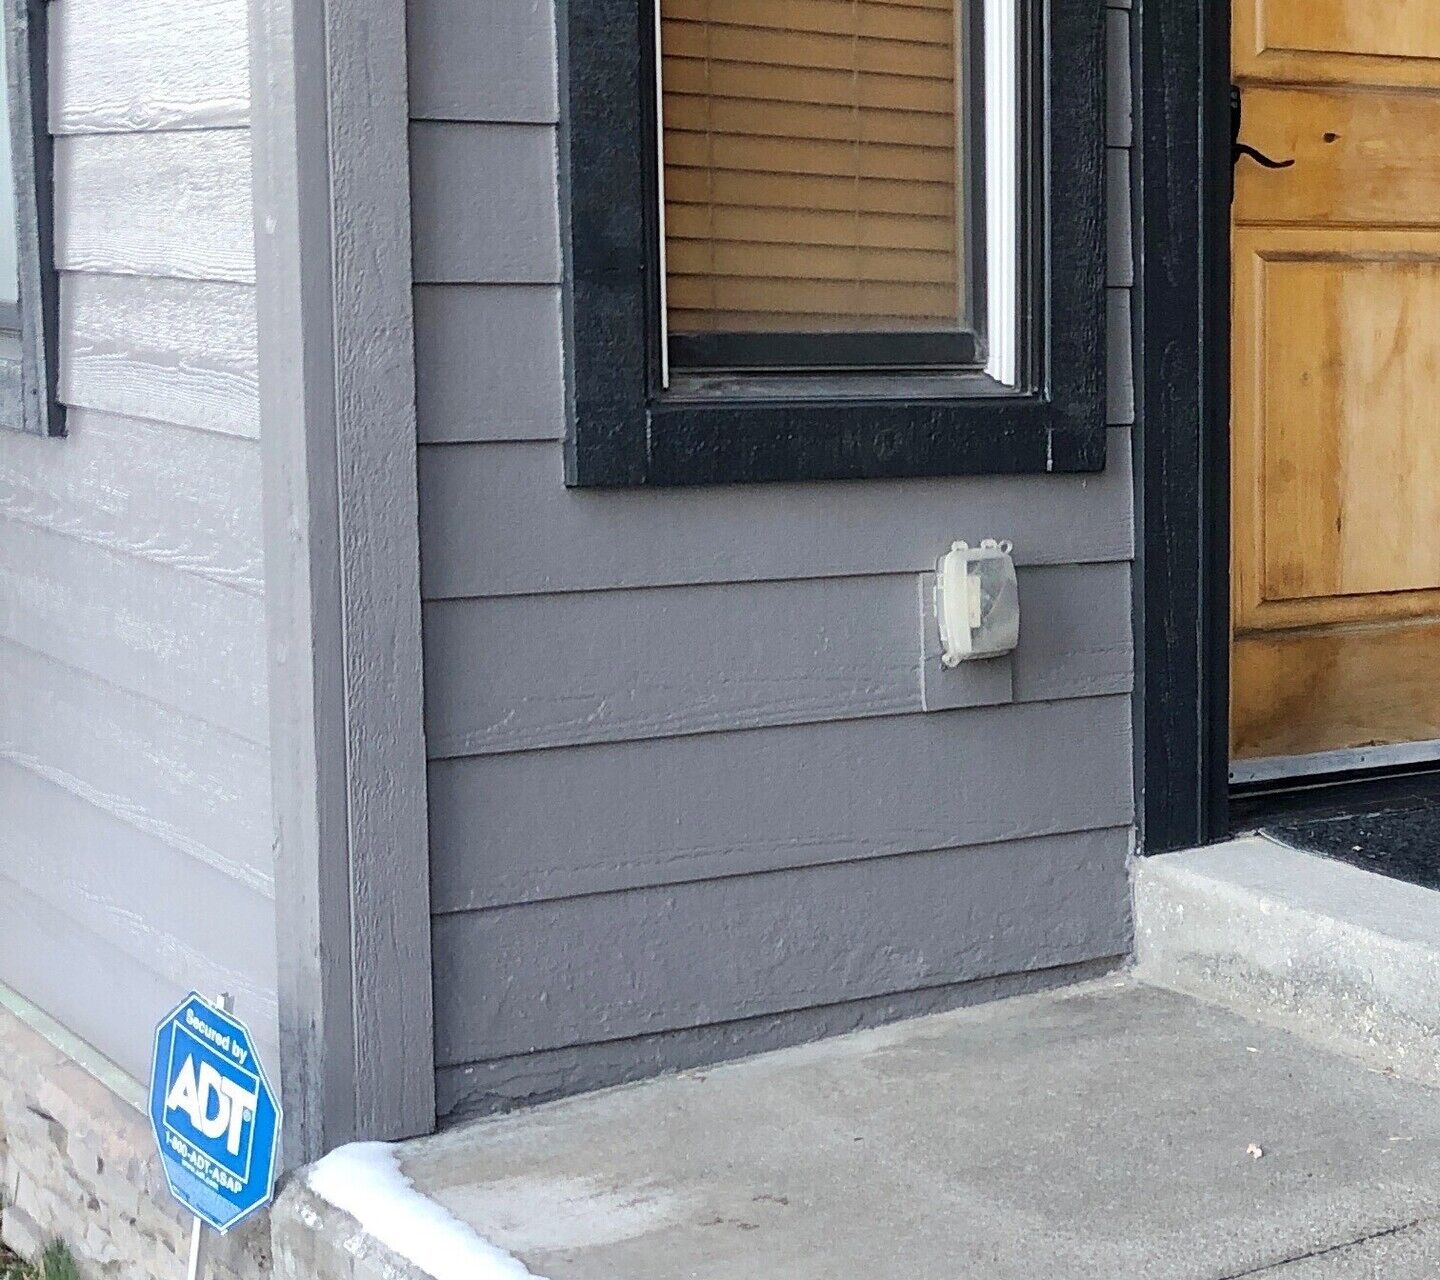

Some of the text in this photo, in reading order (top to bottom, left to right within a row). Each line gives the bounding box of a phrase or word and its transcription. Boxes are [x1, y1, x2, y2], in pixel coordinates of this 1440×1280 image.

[185, 1008, 248, 1065] Secured by
[167, 1053, 257, 1157] ADT
[165, 1131, 243, 1194] 1-800-ADT-ASAP
